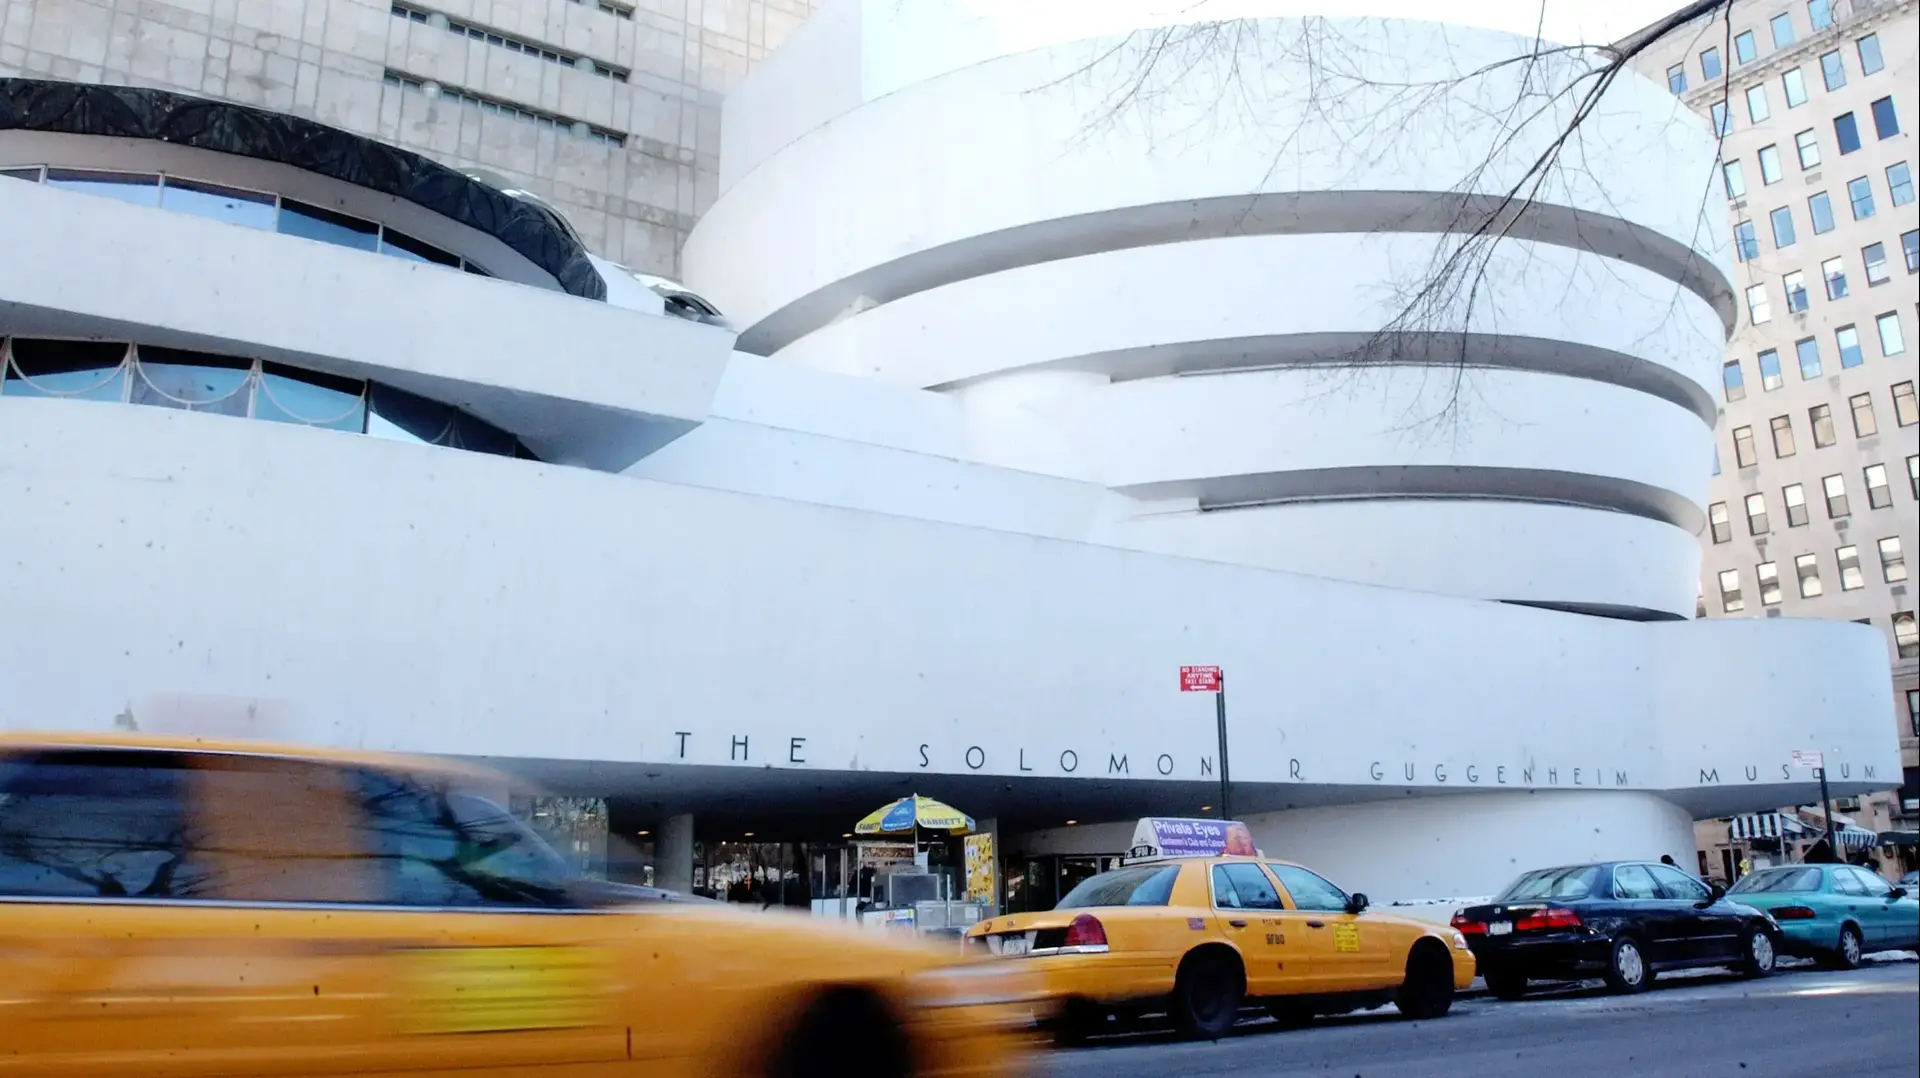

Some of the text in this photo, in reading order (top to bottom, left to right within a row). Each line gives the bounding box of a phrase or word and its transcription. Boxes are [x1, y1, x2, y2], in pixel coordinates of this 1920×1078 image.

[675, 731, 806, 763] THE
[919, 744, 1213, 776] SOLOMON
[1371, 761, 1628, 786] GUGGENHEIM
[1153, 821, 1220, 838] Private Eyes
